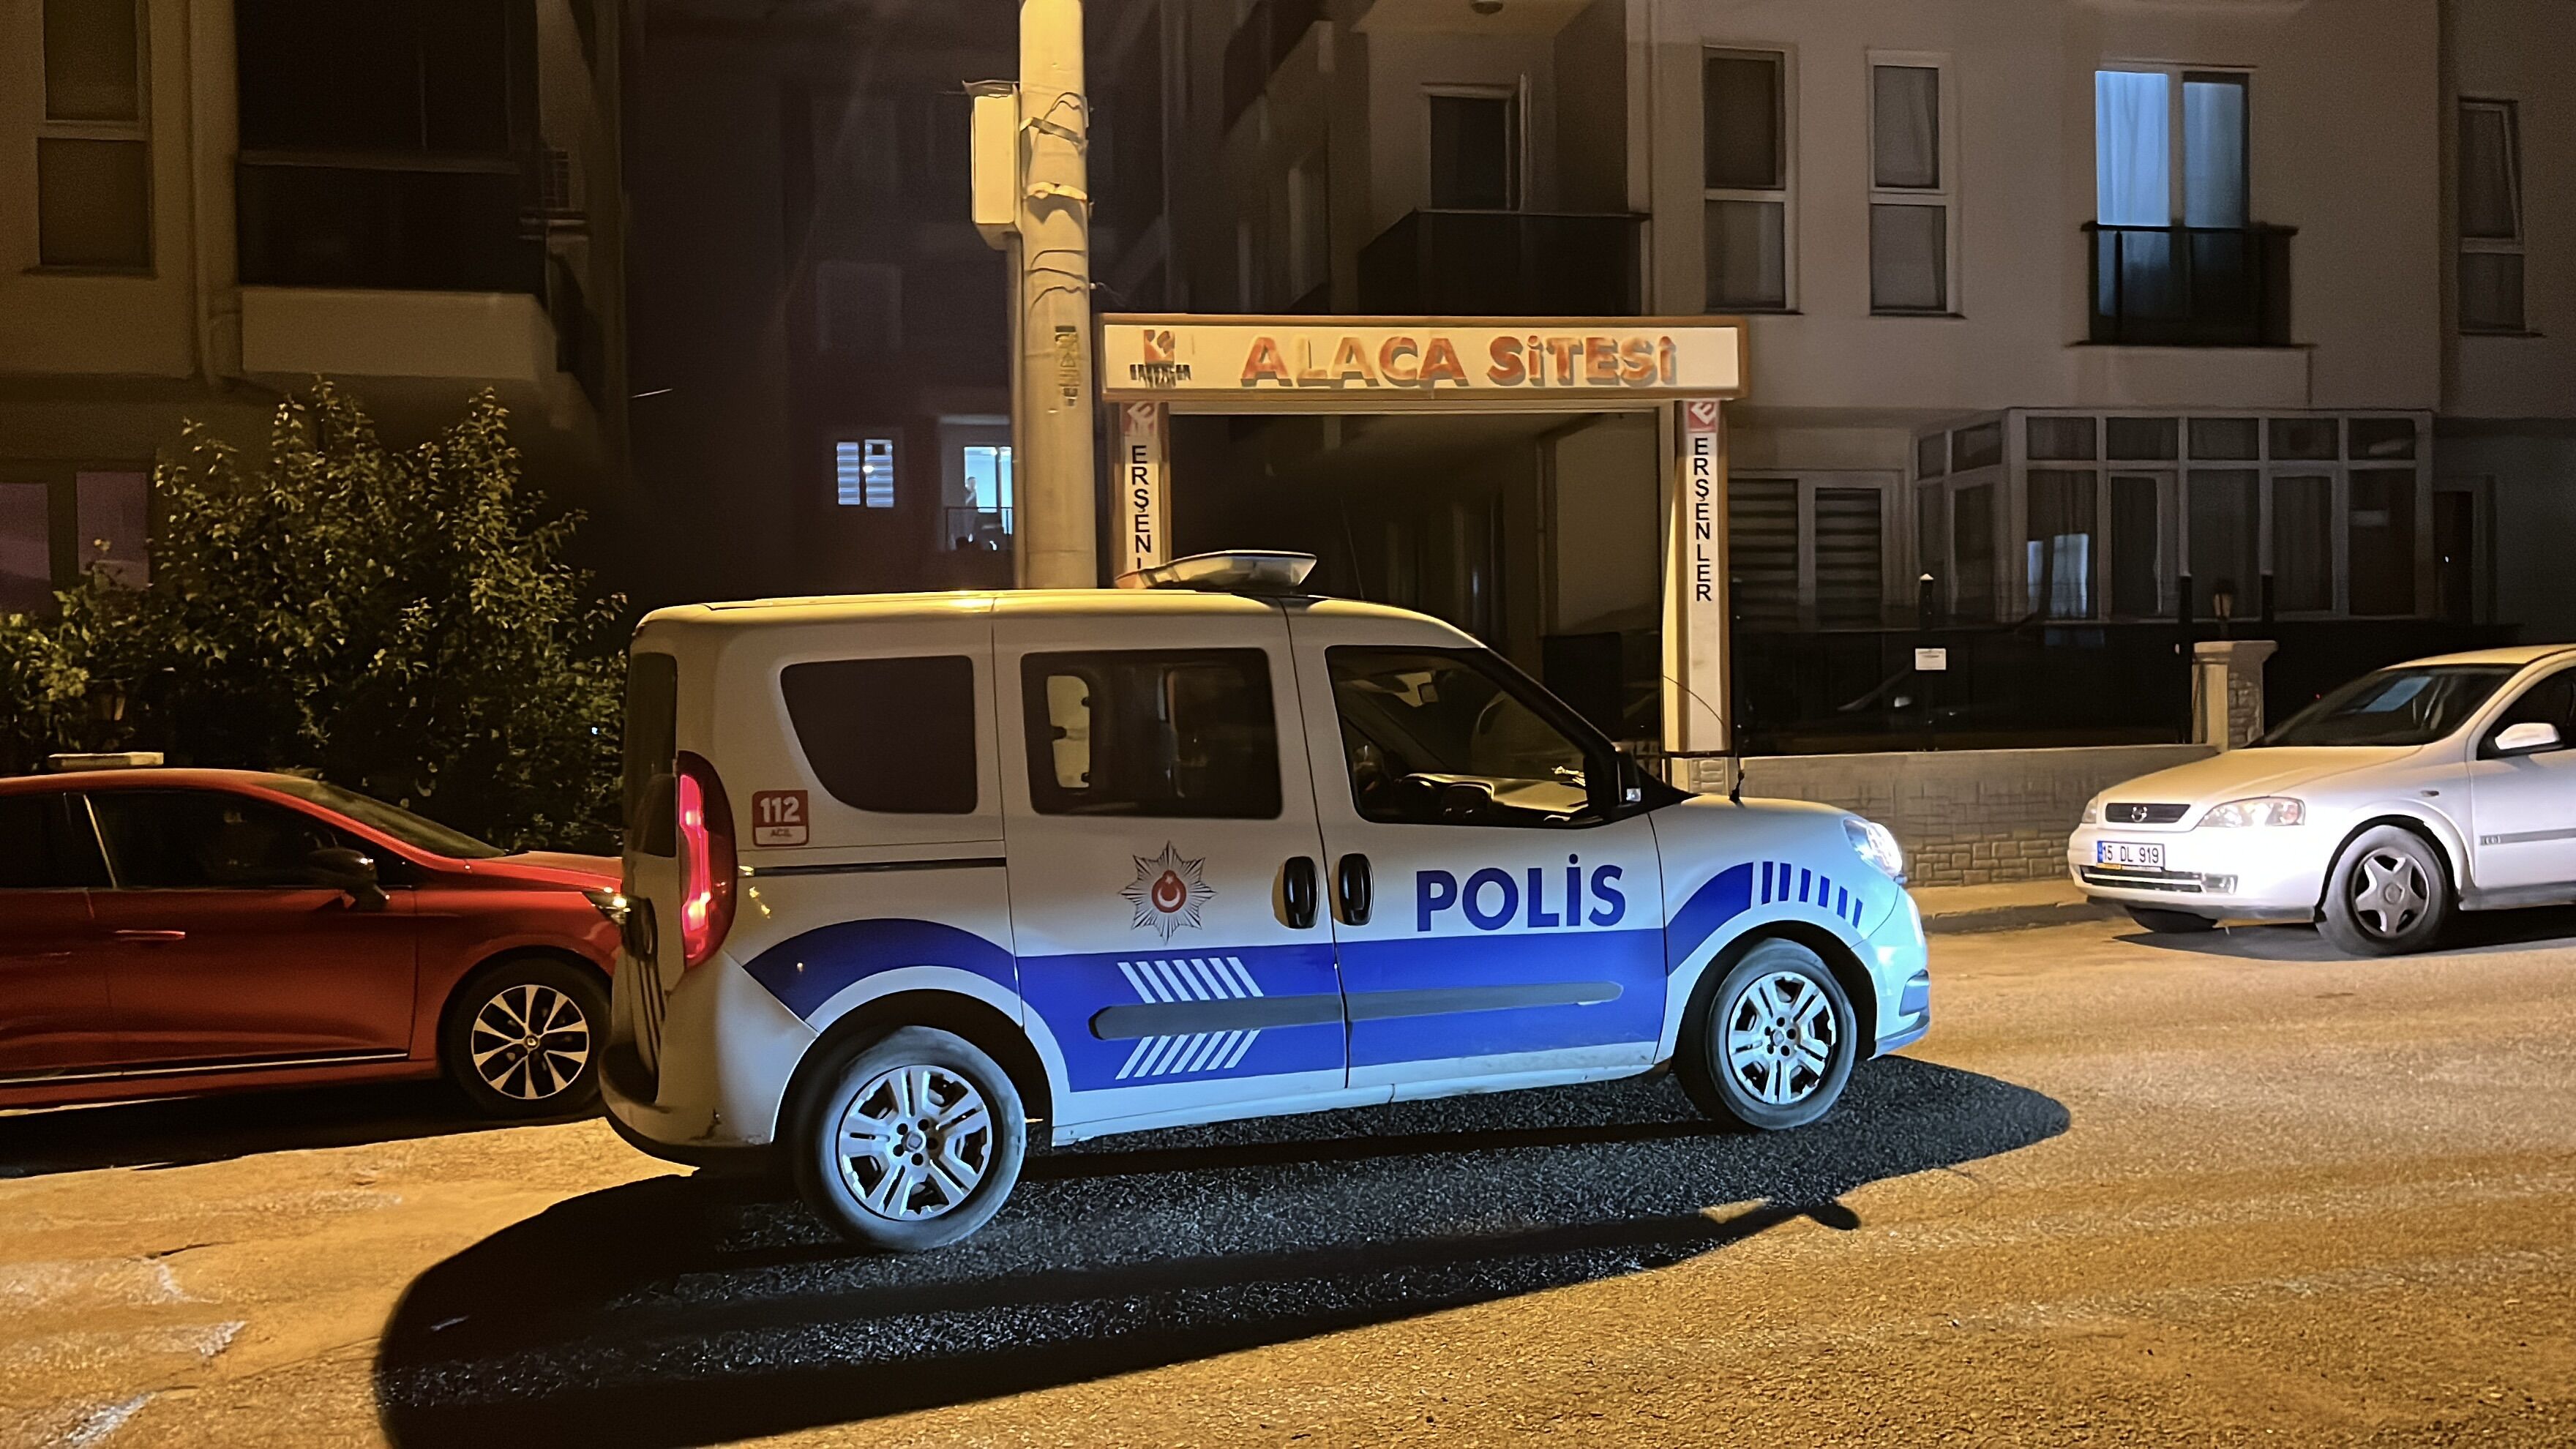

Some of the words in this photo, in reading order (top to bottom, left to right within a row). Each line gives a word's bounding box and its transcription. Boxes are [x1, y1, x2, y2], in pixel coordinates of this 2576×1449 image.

[1241, 335, 1469, 387] ALACA
[1693, 438, 1712, 602] ERŞENLER
[760, 796, 801, 823] 112
[2103, 845, 2113, 861] 15
[2120, 846, 2133, 862] DL
[2139, 847, 2159, 864] 919
[1416, 853, 1626, 932] POLİS
